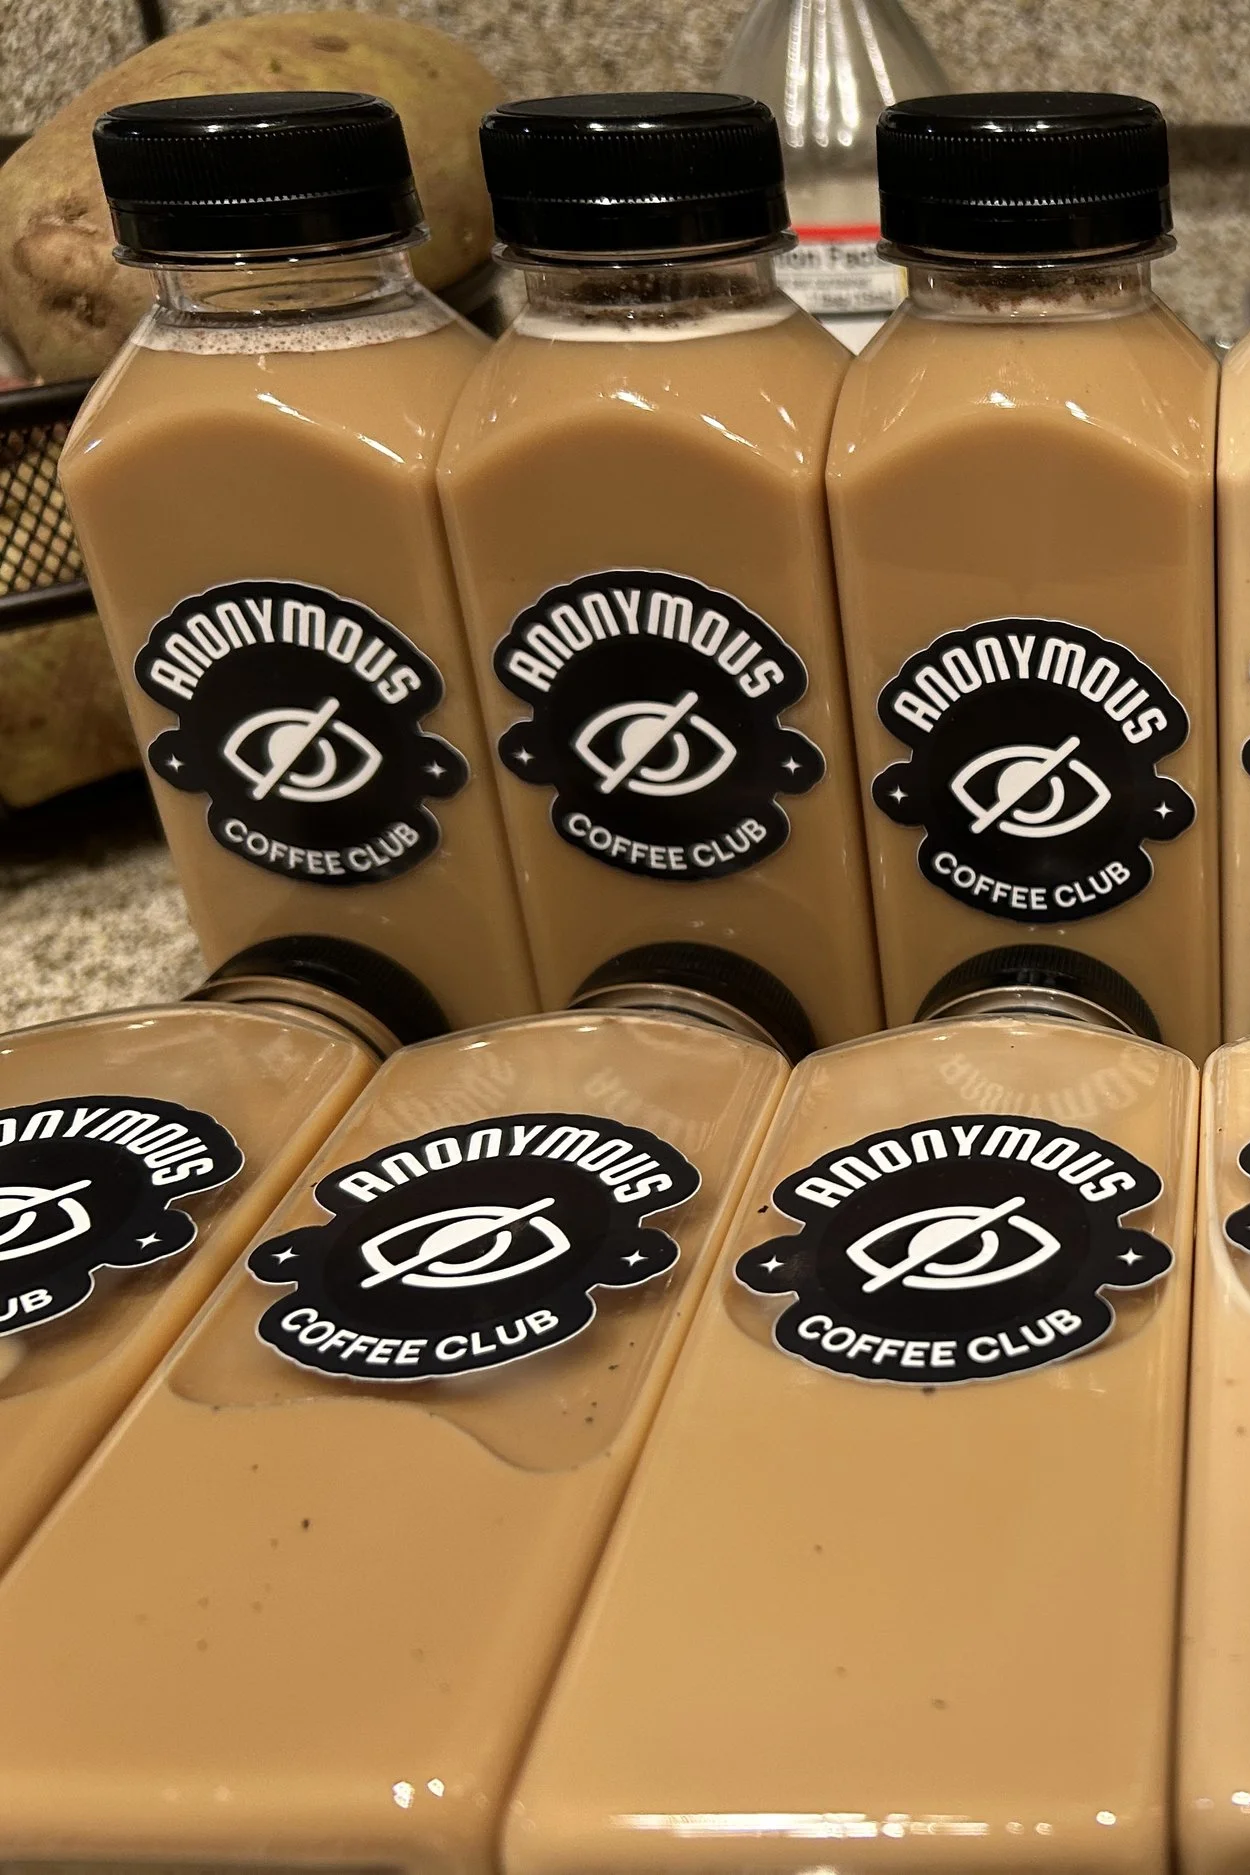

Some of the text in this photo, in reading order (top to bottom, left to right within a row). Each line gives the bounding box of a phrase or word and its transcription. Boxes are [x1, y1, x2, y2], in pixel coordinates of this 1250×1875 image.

[150, 599, 421, 704] ANONYMOUS
[508, 590, 785, 698] ANONYMOUS
[893, 635, 1168, 744] ANONYMOUS
[224, 819, 419, 875] COFFEE CLUB
[568, 813, 767, 870] COFFEE CLUB
[934, 852, 1131, 910] COFFEE CLUB
[338, 1124, 673, 1203] ANONYMOUS
[794, 1124, 1137, 1209] ANONYMOUS
[280, 1307, 559, 1365] COFFEE CLUB
[797, 1309, 1082, 1368] COFFEE CLUB
